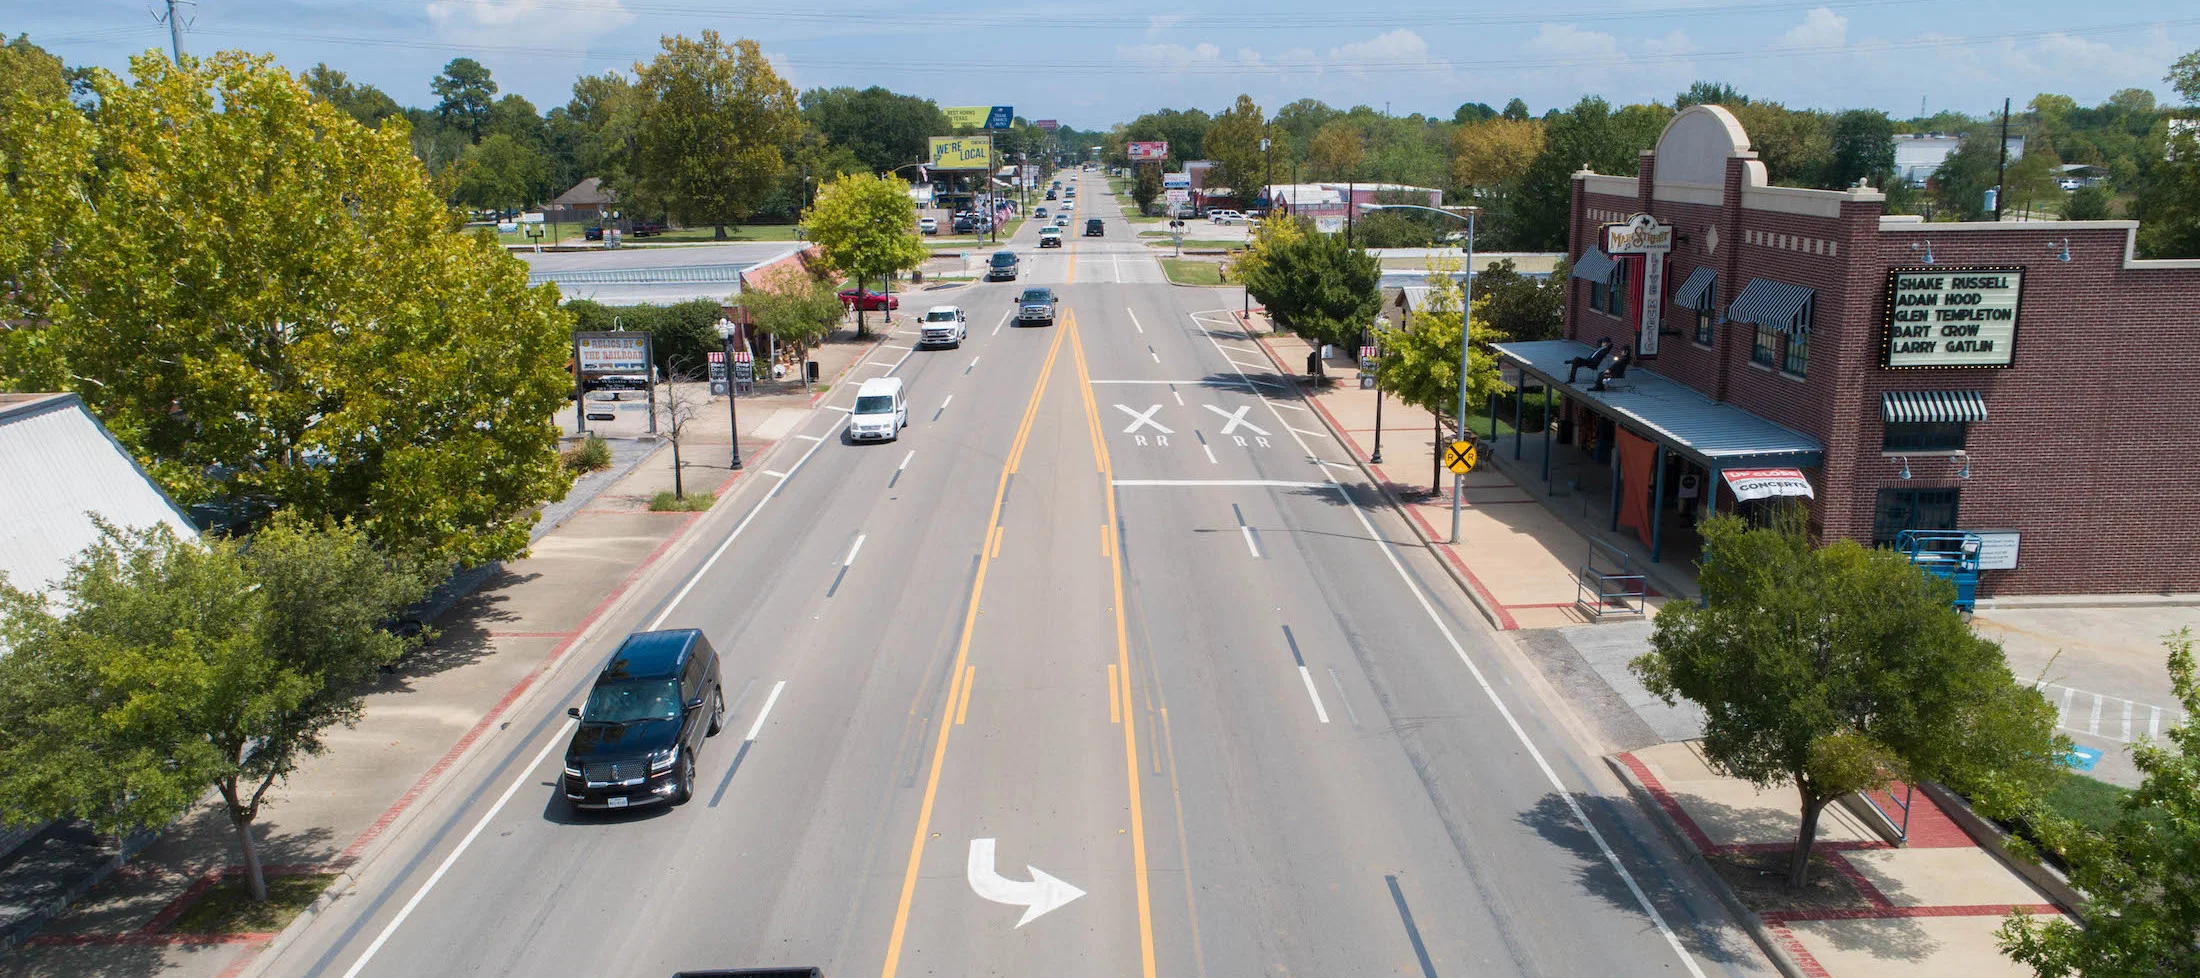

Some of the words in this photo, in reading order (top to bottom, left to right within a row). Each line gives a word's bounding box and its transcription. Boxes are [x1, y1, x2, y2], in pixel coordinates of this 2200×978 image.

[936, 141, 962, 155] WE'RE
[960, 148, 986, 161] LOCAL
[1648, 252, 1659, 295] LIVE
[1899, 277, 1944, 290] SHAKE
[1952, 276, 2009, 289] RUSSELL
[1897, 293, 1937, 306] ADAM
[1944, 293, 1982, 305] HOOD
[1895, 310, 1928, 322] GLEN
[1935, 308, 2012, 321] TEMPLETON
[1645, 299, 1657, 352] MUSIC
[1892, 325, 1931, 338] BART
[1941, 324, 1980, 337] CROW
[592, 340, 621, 349] RELICS
[623, 340, 634, 349] BY
[1893, 341, 1937, 354] LARRY
[1945, 340, 1993, 353] GATLIN
[584, 351, 600, 360] THE
[603, 351, 644, 360] RAILROAD
[1447, 453, 1454, 461] R
[1467, 453, 1475, 461] R
[1740, 481, 1808, 491] CONCERTS
